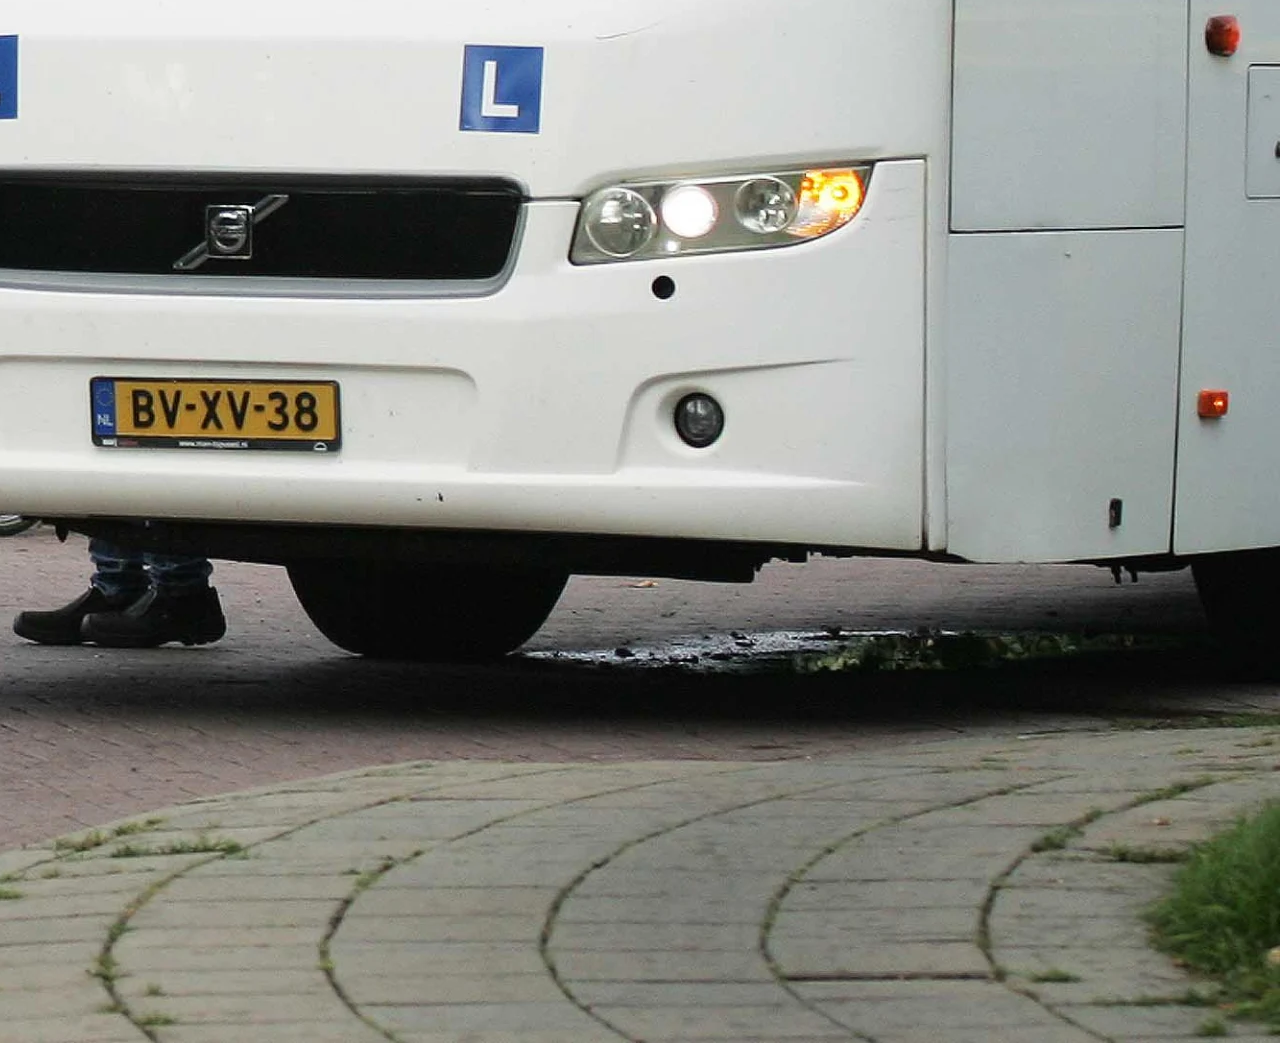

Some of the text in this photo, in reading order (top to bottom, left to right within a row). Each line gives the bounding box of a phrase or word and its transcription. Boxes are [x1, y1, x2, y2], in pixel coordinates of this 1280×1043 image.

[481, 60, 519, 117] L
[97, 413, 114, 427] NL
[131, 388, 319, 432] BV-XV-38
